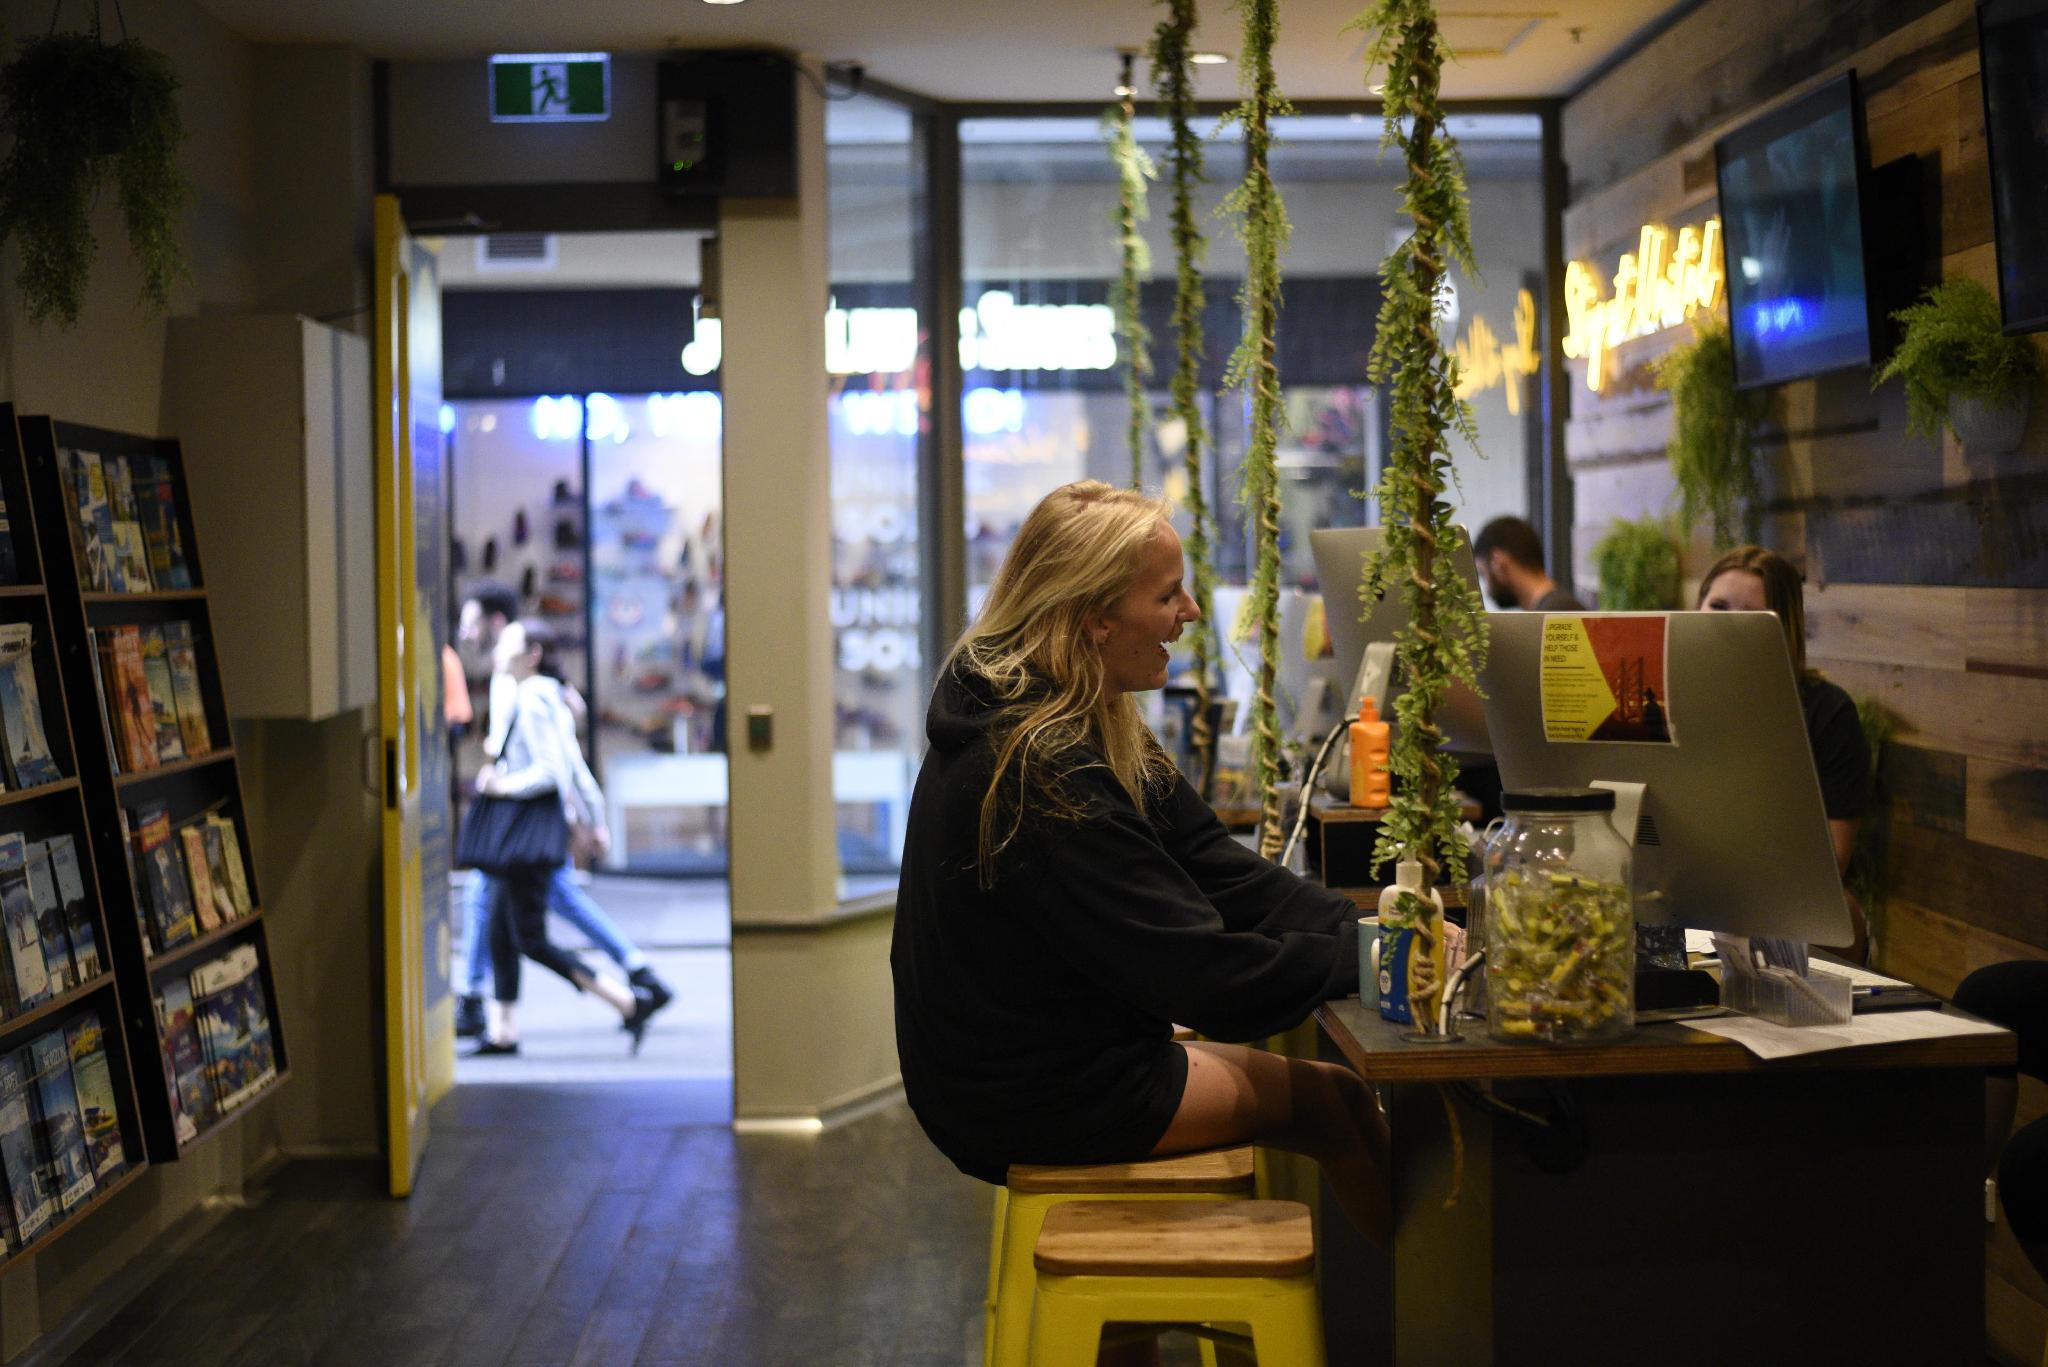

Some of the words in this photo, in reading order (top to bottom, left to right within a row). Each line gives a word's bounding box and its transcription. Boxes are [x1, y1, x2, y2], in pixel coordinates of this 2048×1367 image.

[1545, 634, 1573, 642] YOURSELF
[1544, 644, 1558, 652] HELP
[1559, 644, 1578, 652] THOSE
[1550, 655, 1566, 663] NEED
